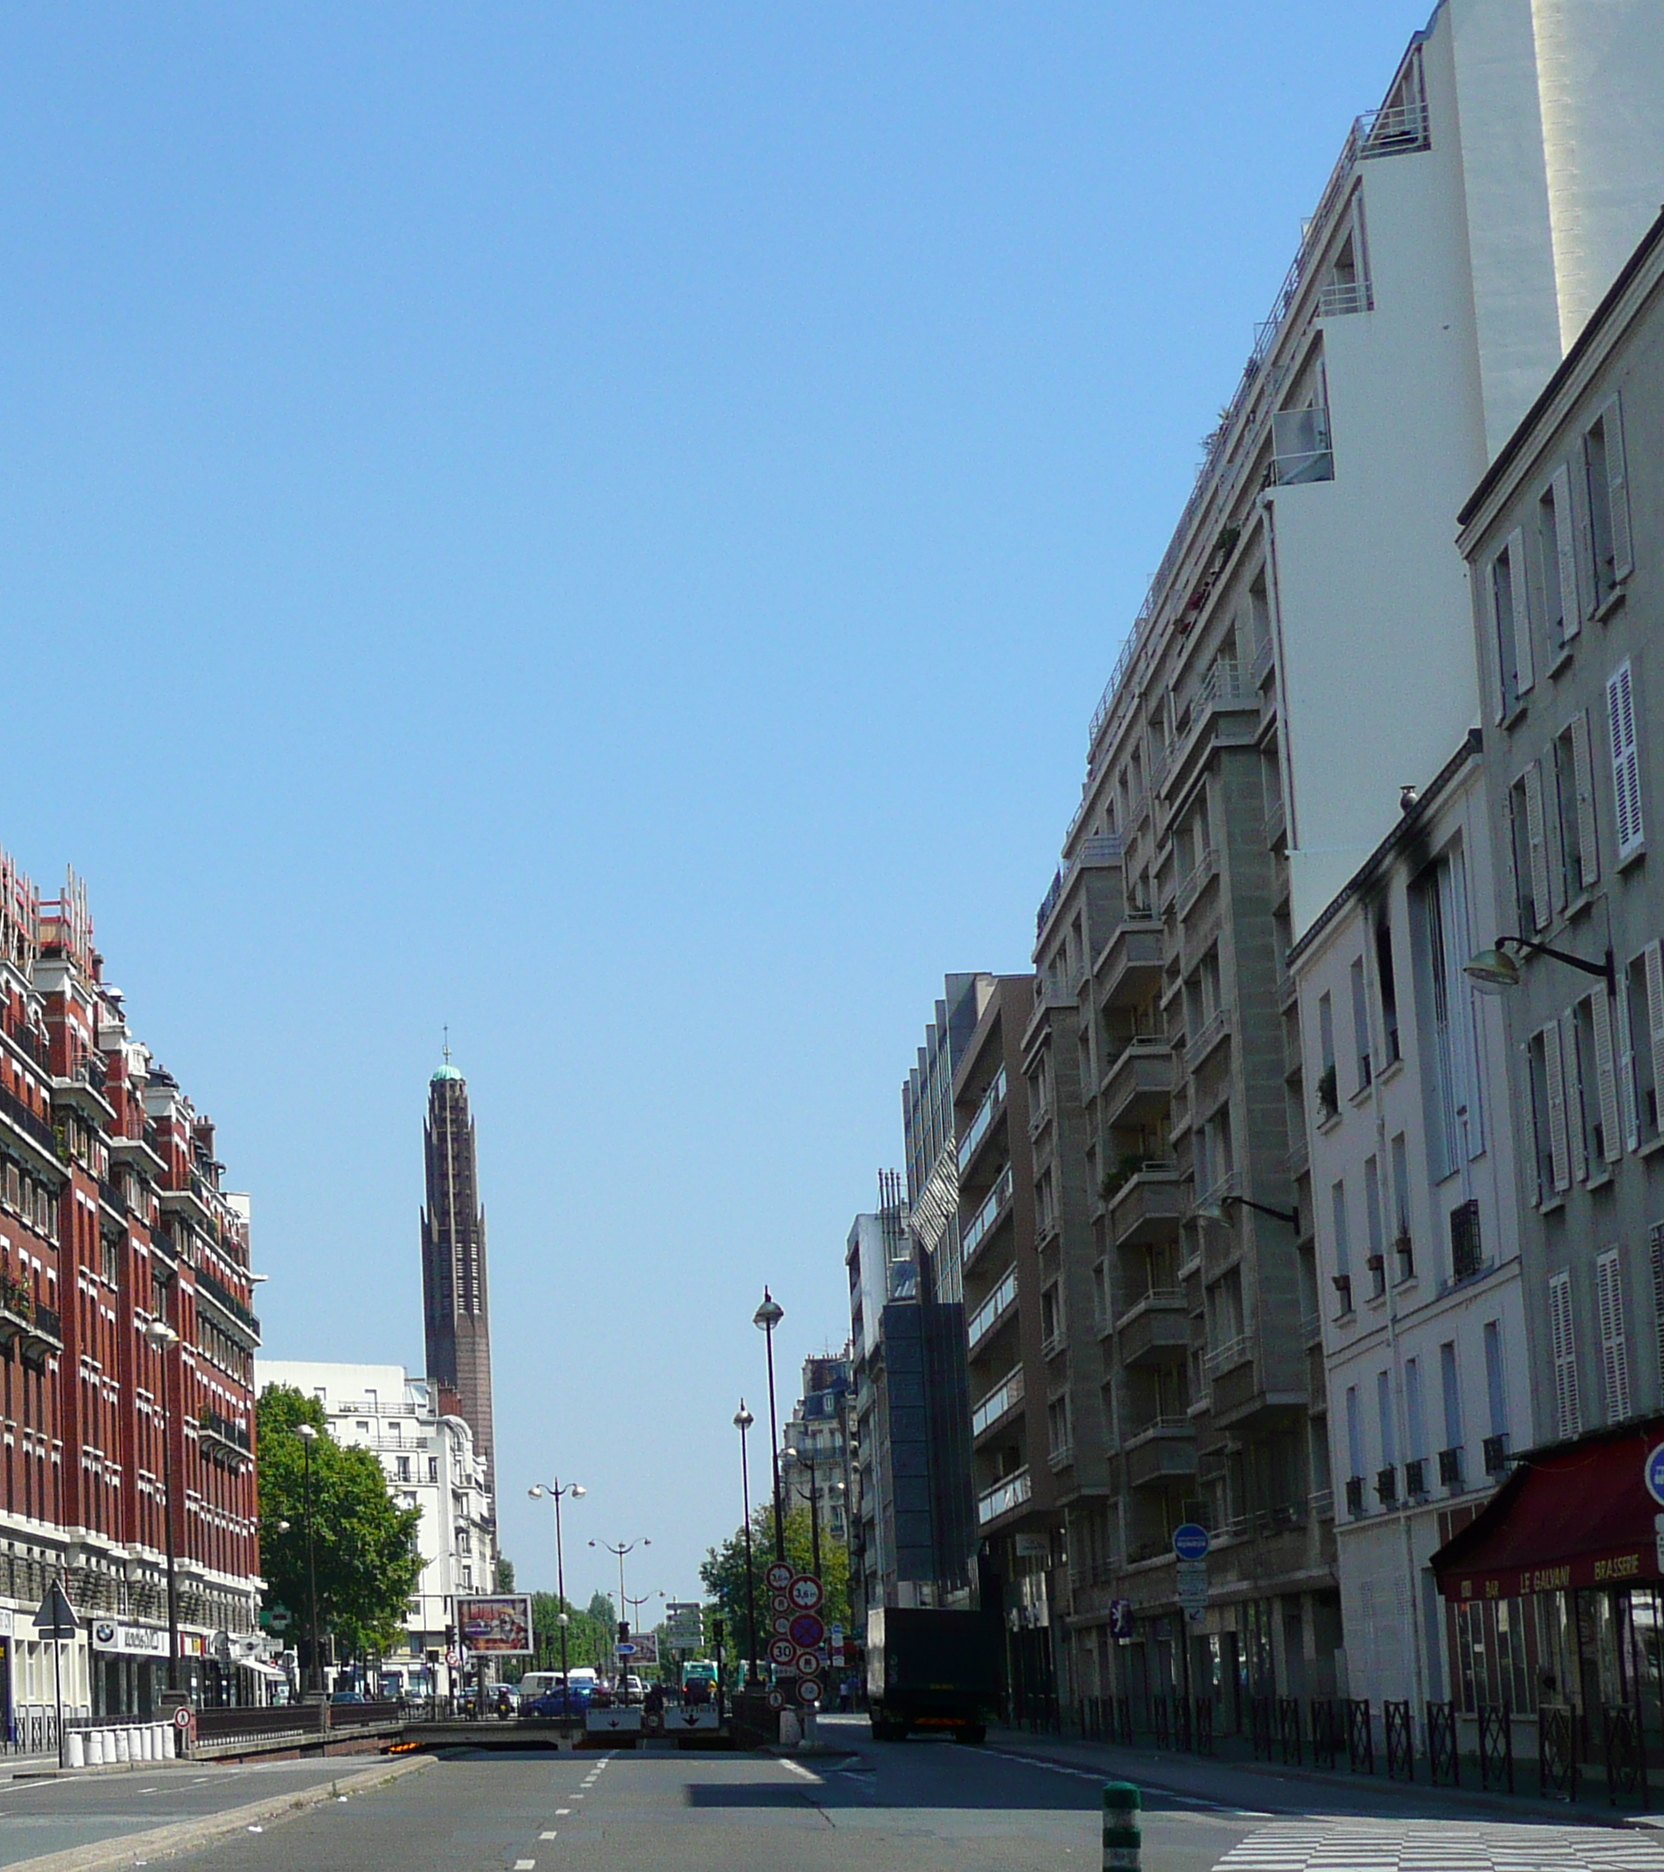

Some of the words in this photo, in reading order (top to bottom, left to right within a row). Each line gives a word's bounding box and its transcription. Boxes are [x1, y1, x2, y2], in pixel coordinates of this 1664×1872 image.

[1486, 1580, 1499, 1598] BAR
[1519, 1573, 1530, 1594] LE
[1534, 1566, 1571, 1590] GALVANI
[1594, 1554, 1640, 1580] BRASSERIE
[775, 1646, 791, 1658] 30
